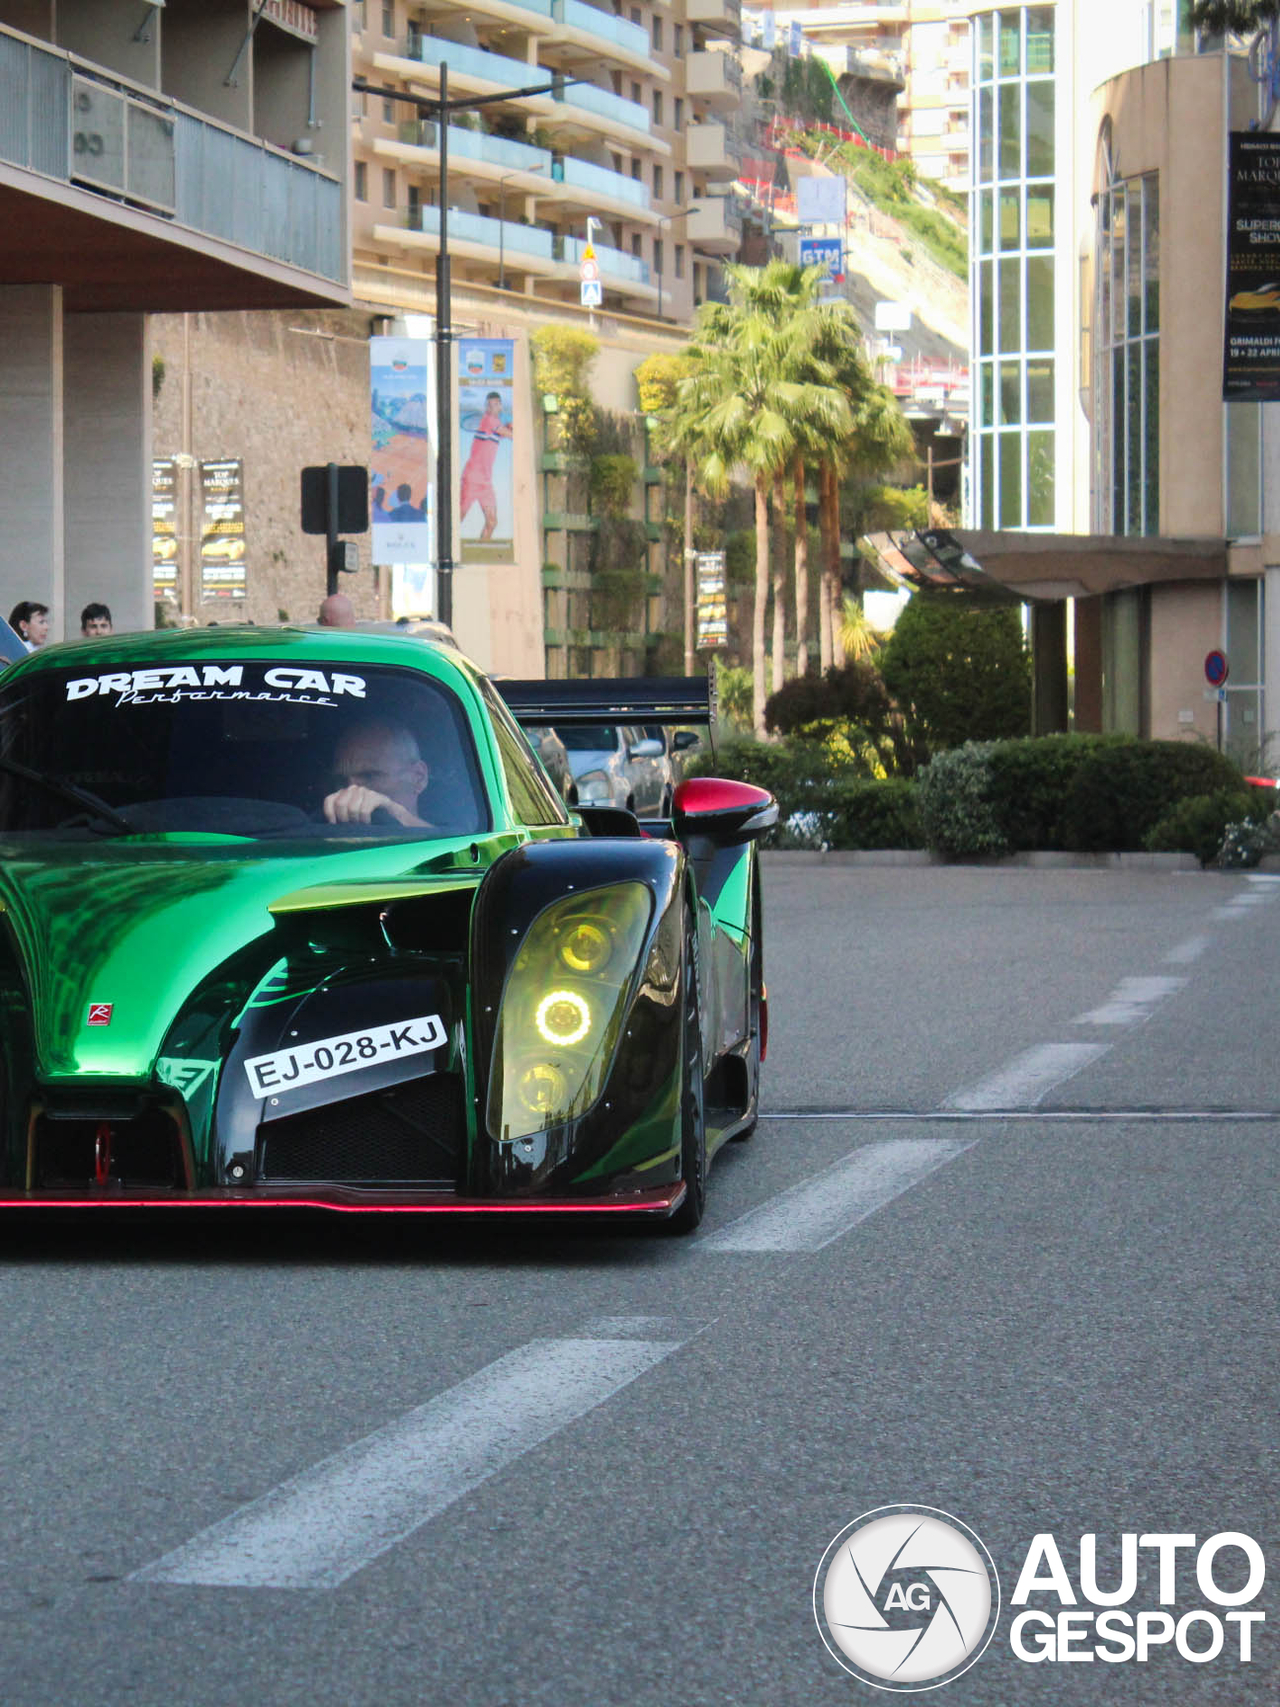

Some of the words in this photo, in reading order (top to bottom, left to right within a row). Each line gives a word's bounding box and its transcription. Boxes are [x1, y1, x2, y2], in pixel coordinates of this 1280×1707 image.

[802, 249, 840, 267] GTM
[1230, 337, 1273, 346] GRIMALDI
[66, 666, 243, 701] DREAM
[264, 667, 366, 698] CAR
[115, 689, 338, 708] Performance
[254, 1021, 438, 1089] EJ-028-KJ
